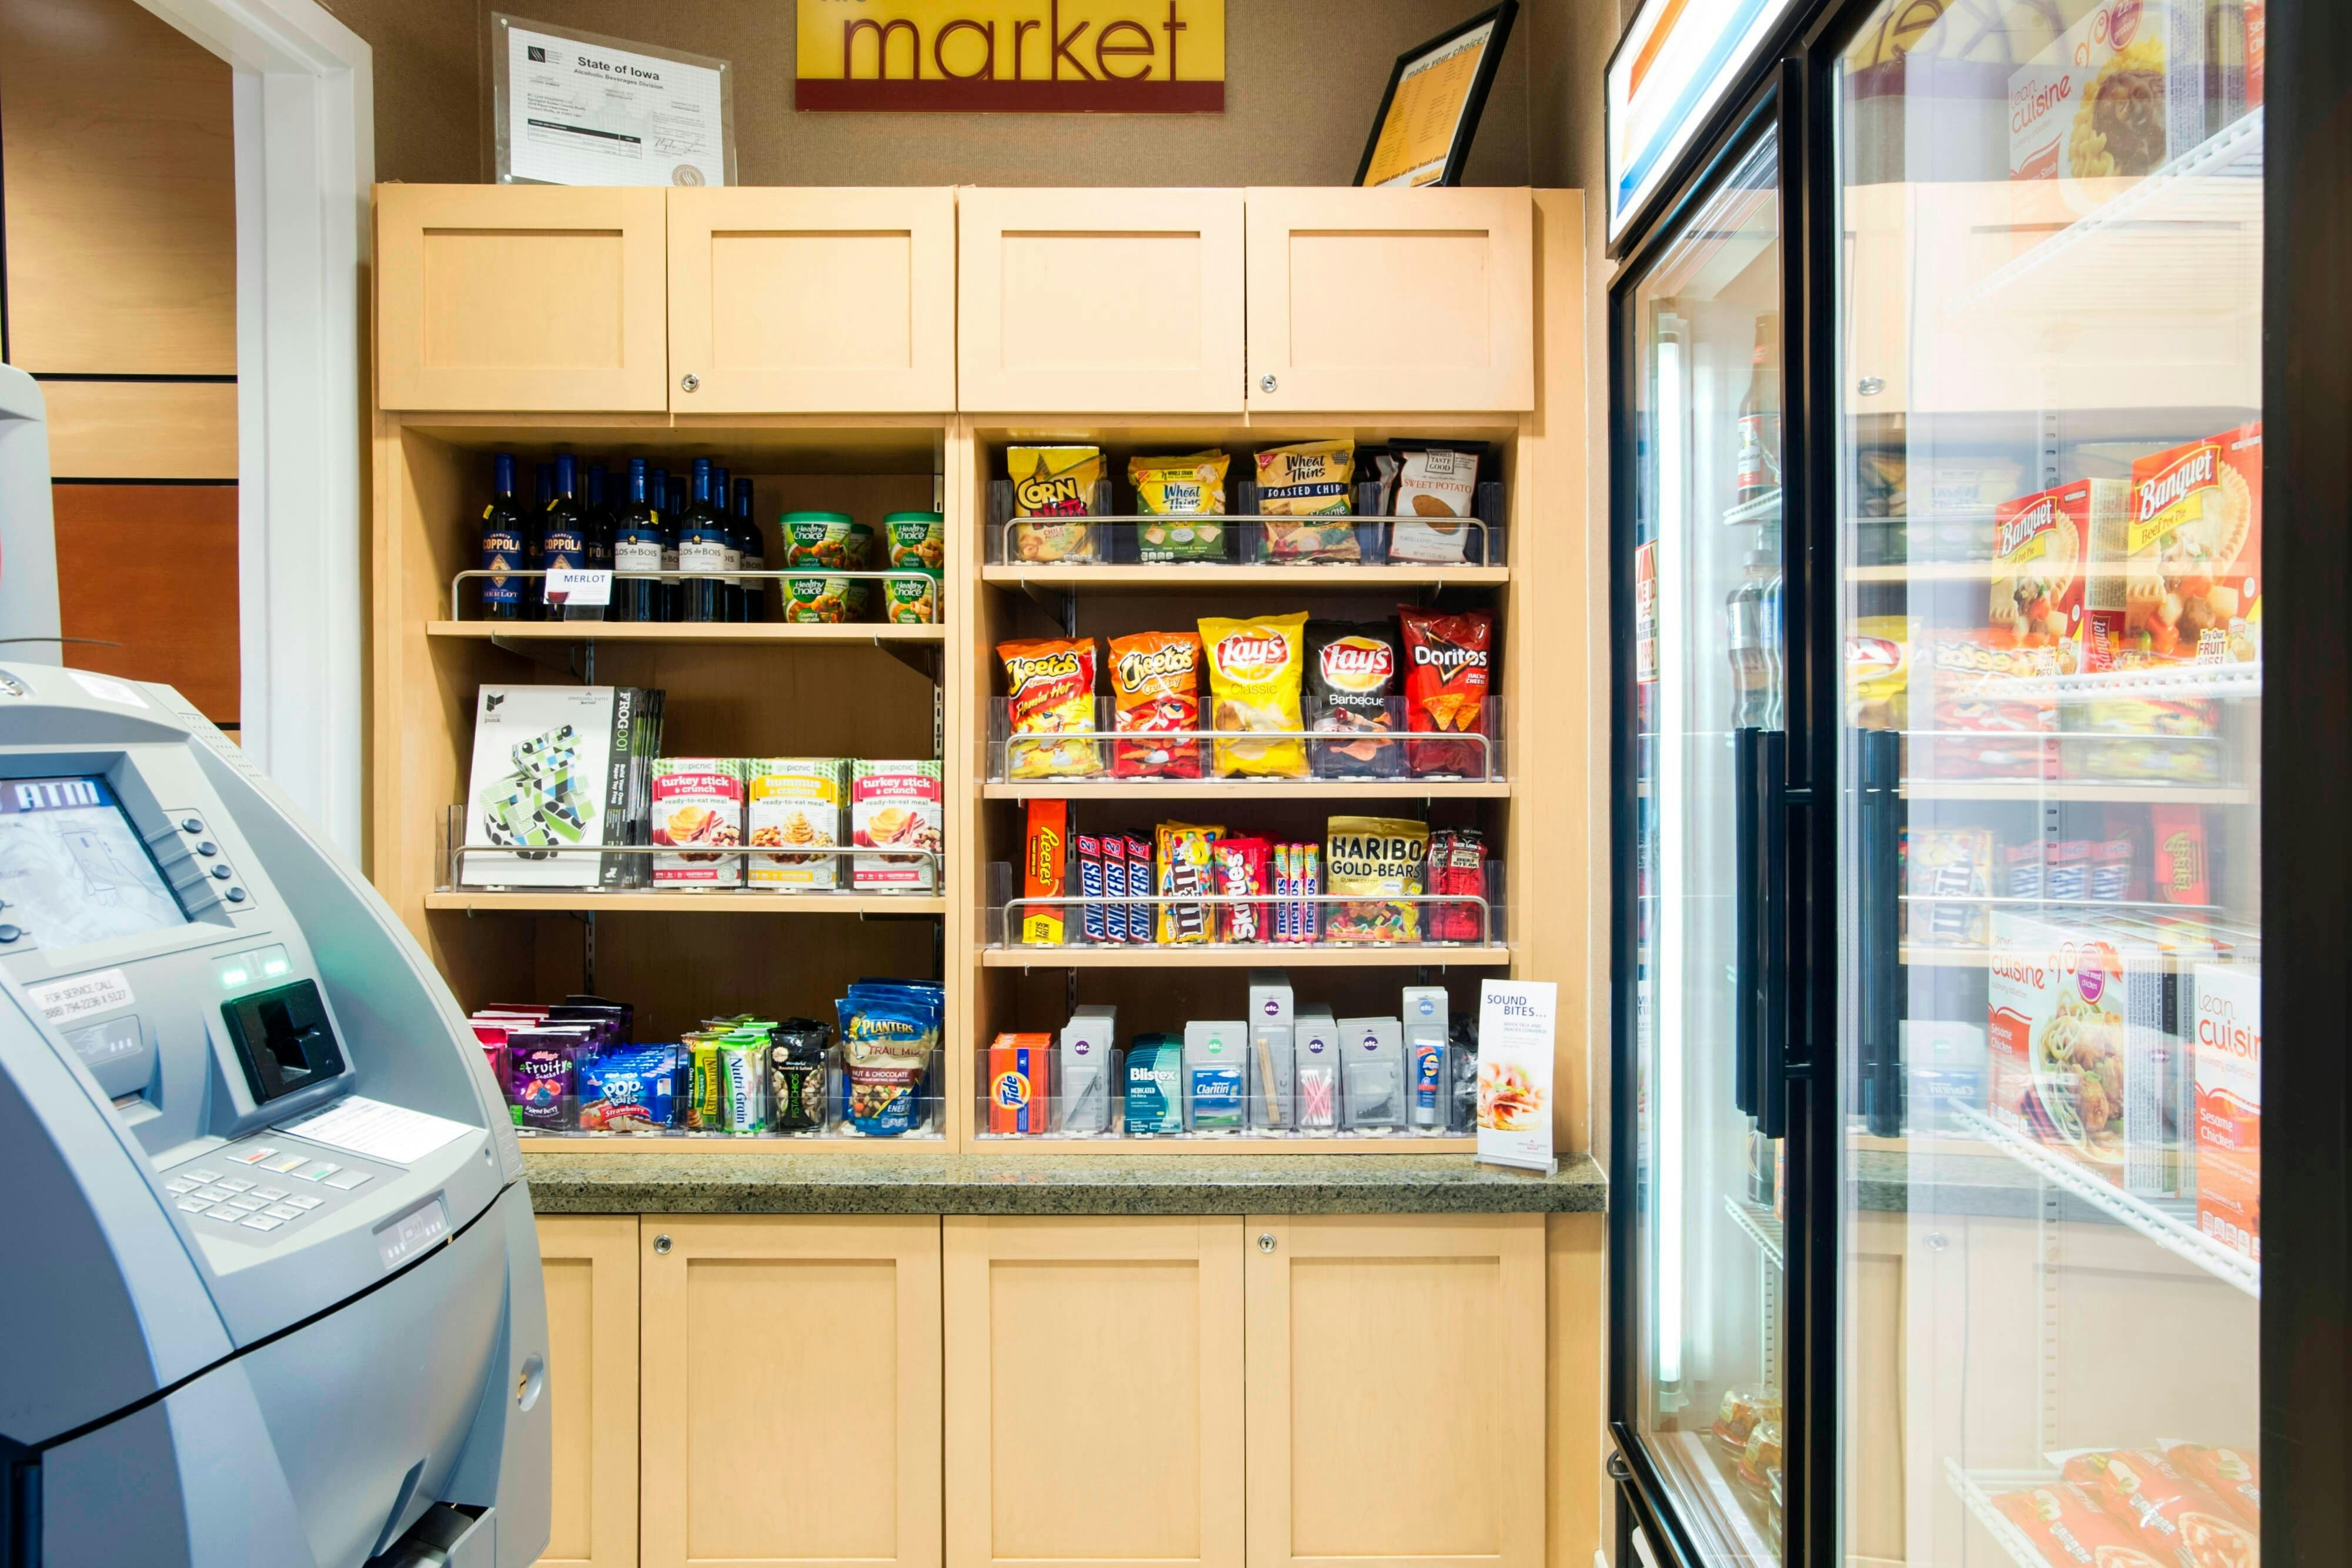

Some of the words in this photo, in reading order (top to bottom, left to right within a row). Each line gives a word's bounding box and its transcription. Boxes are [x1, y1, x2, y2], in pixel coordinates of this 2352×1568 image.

[844, 0, 1187, 82] market
[1406, 62, 1429, 80] made
[1431, 52, 1451, 70] your
[1452, 31, 1489, 57] choice?
[578, 56, 610, 72] State
[614, 65, 628, 75] of
[630, 66, 660, 81] Iowa
[574, 69, 603, 79] Alcoholic
[605, 74, 638, 86] Beverages
[639, 81, 664, 90] Division
[2012, 81, 2036, 108] lean
[2012, 75, 2070, 133] cuisine
[1285, 455, 1325, 471] Wheat
[1287, 467, 1325, 483] Thins
[1018, 477, 1078, 510] CORN
[1164, 483, 1201, 499] Wheat
[1267, 487, 1314, 497] TOASTED
[1404, 480, 1434, 489] SWEET
[1435, 482, 1472, 493] POTATO
[2140, 450, 2212, 521] Banquet
[1162, 499, 1201, 510] Thins
[796, 524, 825, 533] Healthy
[898, 524, 927, 533] Healthy
[2002, 500, 2051, 554] Banquet
[2141, 520, 2161, 544] Beef
[2162, 515, 2173, 528] Pot
[2174, 508, 2186, 521] Pie
[794, 531, 823, 540] Choice
[896, 531, 924, 540] Choice
[483, 539, 521, 551] COPPOLA
[544, 539, 582, 551] COPPOLA
[792, 587, 821, 595] Choice
[795, 579, 824, 589] Healthy
[893, 587, 922, 597] Choice
[896, 580, 924, 589] Healthy
[2201, 631, 2212, 641] Try
[2213, 630, 2223, 639] Our
[1222, 636, 1282, 666] Lay's
[2093, 620, 2113, 672] Banquet
[2199, 641, 2225, 655] FRUIT
[1328, 646, 1389, 674] Lay's
[1415, 646, 1487, 666] Doritos
[1006, 653, 1079, 696] Cheetos
[1120, 646, 1192, 690] Cheetos
[1051, 682, 1074, 697] Hot
[1231, 683, 1277, 695] Classic
[1329, 694, 1384, 706] Barbecue
[662, 777, 699, 787] turkey
[701, 777, 729, 787] stick
[863, 778, 901, 788] turkey
[903, 778, 930, 787] stick
[15, 780, 101, 809] ATM
[1040, 825, 1060, 886] Reese's
[1332, 836, 1422, 861] HARIBO
[1331, 861, 1421, 879] GOLD-BEARS
[1992, 955, 2045, 989] cuisine
[45, 993, 61, 1004] FOR
[63, 984, 95, 999] SERVICE
[95, 980, 114, 991] CALL
[1487, 994, 1527, 1005] SOUND
[2199, 985, 2236, 1020] lean
[1504, 1007, 1546, 1018] BITES...
[862, 1021, 913, 1035] PLANTERS
[1991, 1024, 2012, 1040] Sesame
[869, 1045, 898, 1056] TRAIL
[901, 1047, 921, 1056] MIX
[1991, 1037, 2012, 1053] Chicken
[707, 1059, 716, 1086] NATURE
[731, 1058, 744, 1089] Nutri
[1130, 1068, 1176, 1084] Blistex
[1003, 1075, 1023, 1106] Tide
[1197, 1084, 1229, 1094] Claritin
[707, 1089, 716, 1114] VALLEY
[736, 1091, 747, 1124] Grain
[606, 1106, 644, 1117] Strawberry
[666, 1114, 672, 1124] 2
[2200, 1108, 2233, 1132] Sesame
[2201, 1126, 2234, 1151] Chicken
